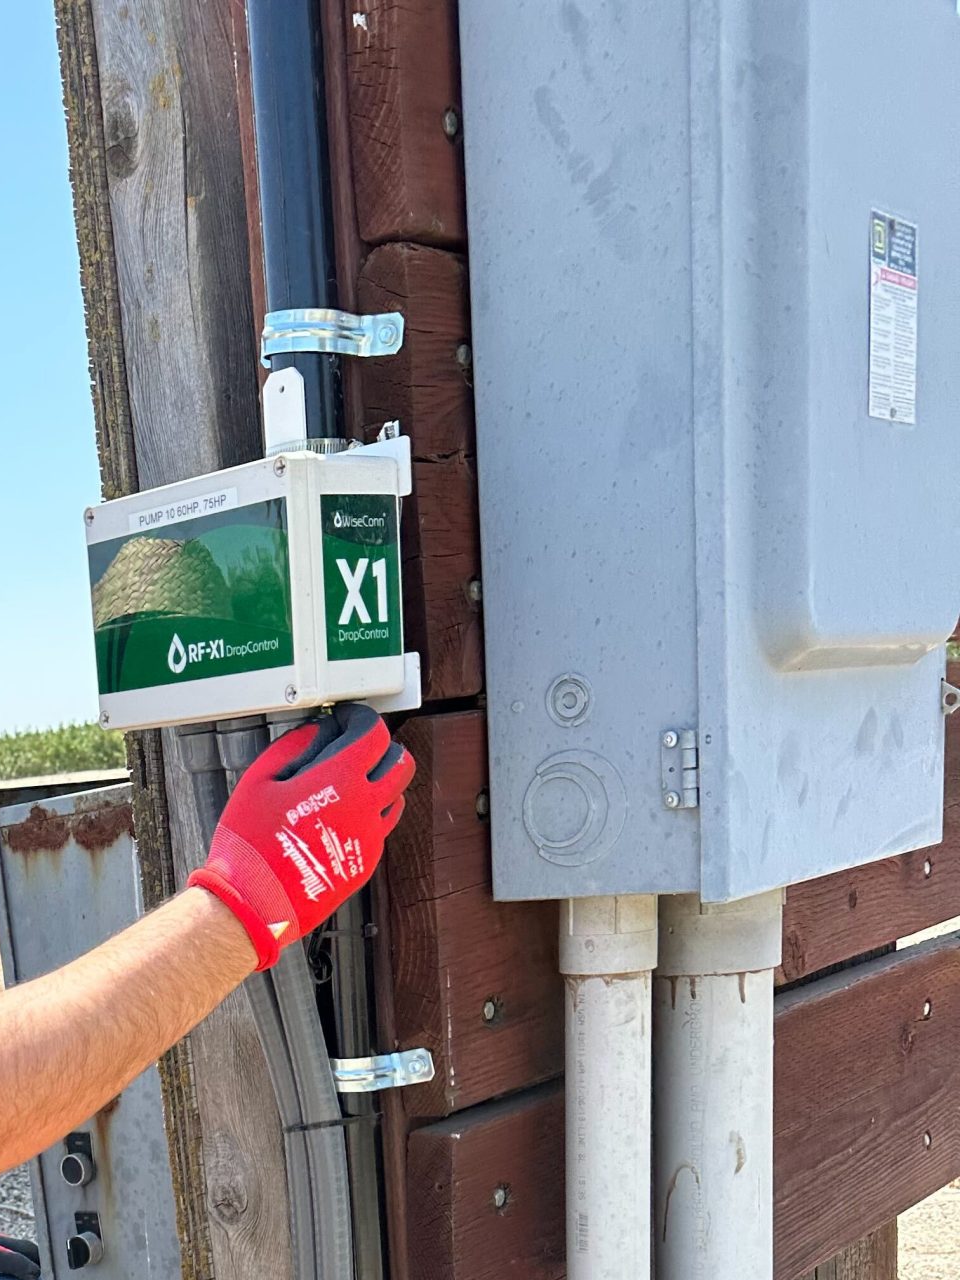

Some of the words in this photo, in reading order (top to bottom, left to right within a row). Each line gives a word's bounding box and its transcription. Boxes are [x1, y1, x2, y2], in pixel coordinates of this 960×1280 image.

[139, 510, 164, 527] PUMP
[165, 507, 176, 521] 10
[204, 494, 228, 511] 75HP
[341, 513, 385, 528] WiseConn
[335, 557, 389, 625] X1
[339, 627, 389, 643] DropControl
[187, 638, 225, 663] RF-X1
[226, 637, 279, 657] DropControl
[276, 831, 326, 902] Milwaukee
